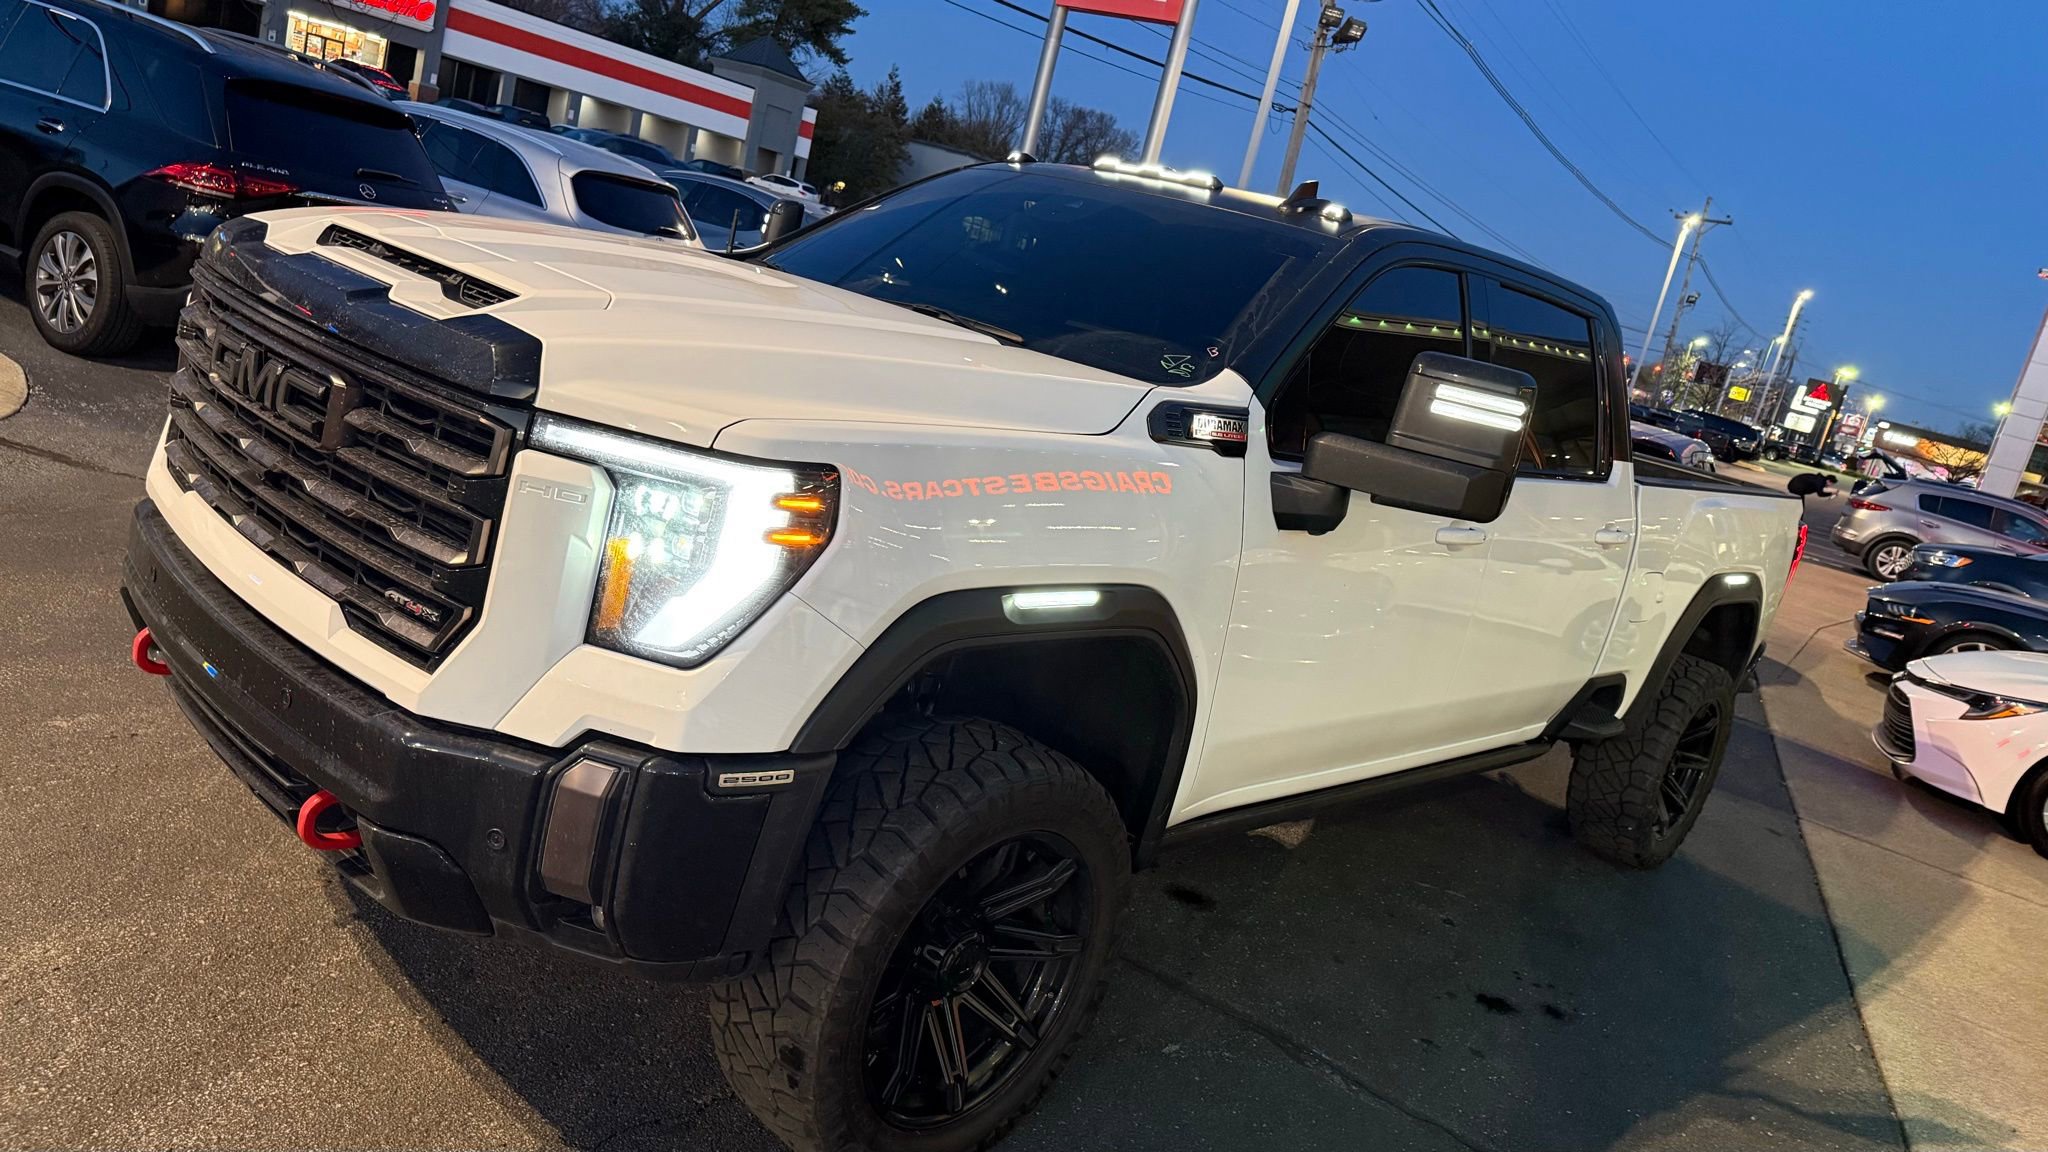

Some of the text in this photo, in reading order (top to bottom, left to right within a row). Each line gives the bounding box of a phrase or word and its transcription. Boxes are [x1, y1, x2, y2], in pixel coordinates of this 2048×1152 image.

[210, 331, 328, 434] GMC
[1197, 417, 1245, 433] DURAMAX
[519, 480, 588, 505] HD
[384, 590, 440, 622] AT4X
[721, 772, 792, 785] 2500
